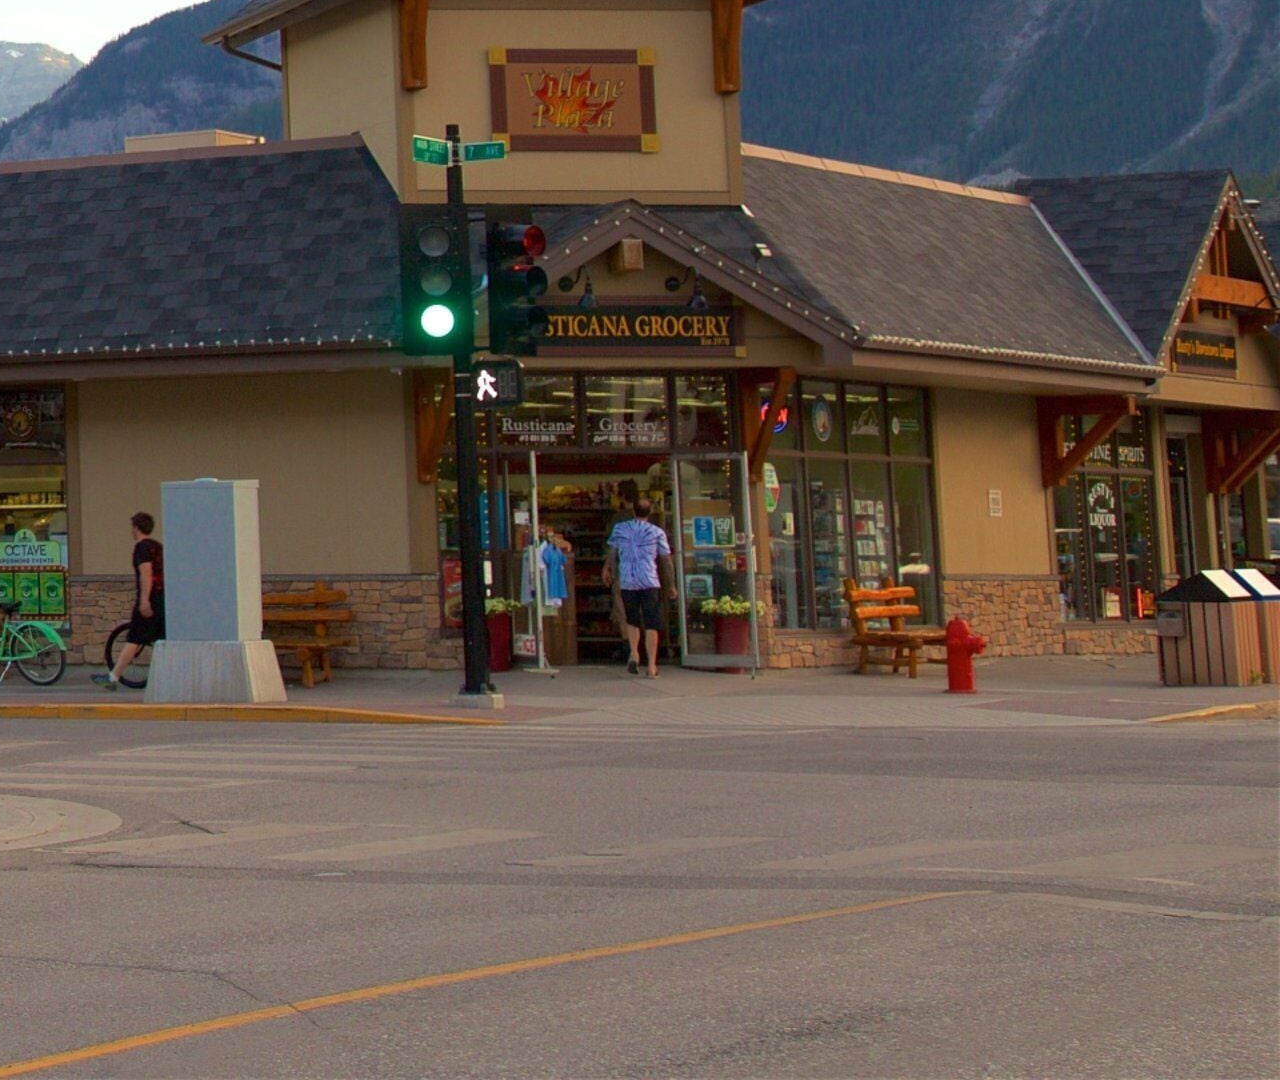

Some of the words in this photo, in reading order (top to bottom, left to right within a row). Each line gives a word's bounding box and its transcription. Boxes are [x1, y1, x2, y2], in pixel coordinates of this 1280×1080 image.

[521, 66, 625, 108] Village
[532, 101, 615, 130] Plaza
[545, 315, 631, 338] STICANA
[635, 315, 731, 338] GROCERY
[501, 417, 574, 433] Rusticana
[598, 417, 659, 435] Grocery
[1088, 512, 1117, 530] LIQUOR
[4, 544, 48, 557] OCTAVE
